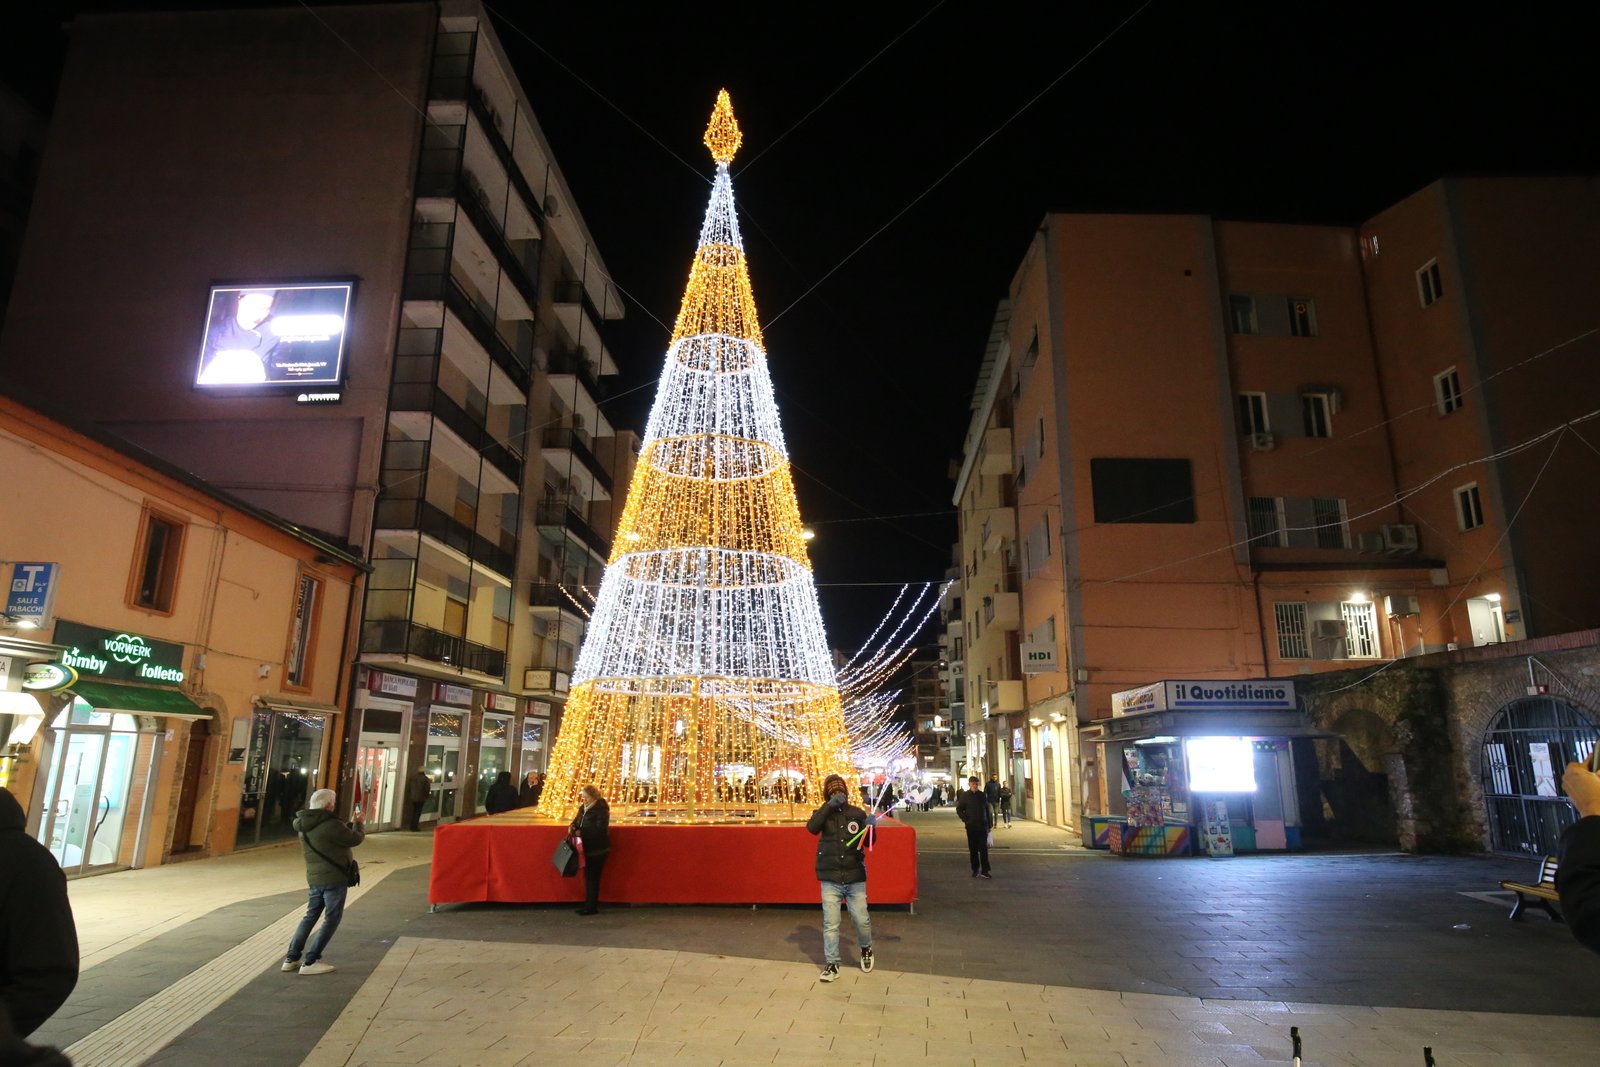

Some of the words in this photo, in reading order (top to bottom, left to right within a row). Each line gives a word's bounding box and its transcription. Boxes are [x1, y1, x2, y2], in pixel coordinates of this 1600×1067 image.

[104, 639, 152, 658] VORWERK
[1028, 652, 1051, 660] HDI
[62, 647, 107, 674] bimby
[141, 663, 184, 683] folletto
[1175, 684, 1187, 700] il
[1190, 684, 1286, 700] Quotidiano
